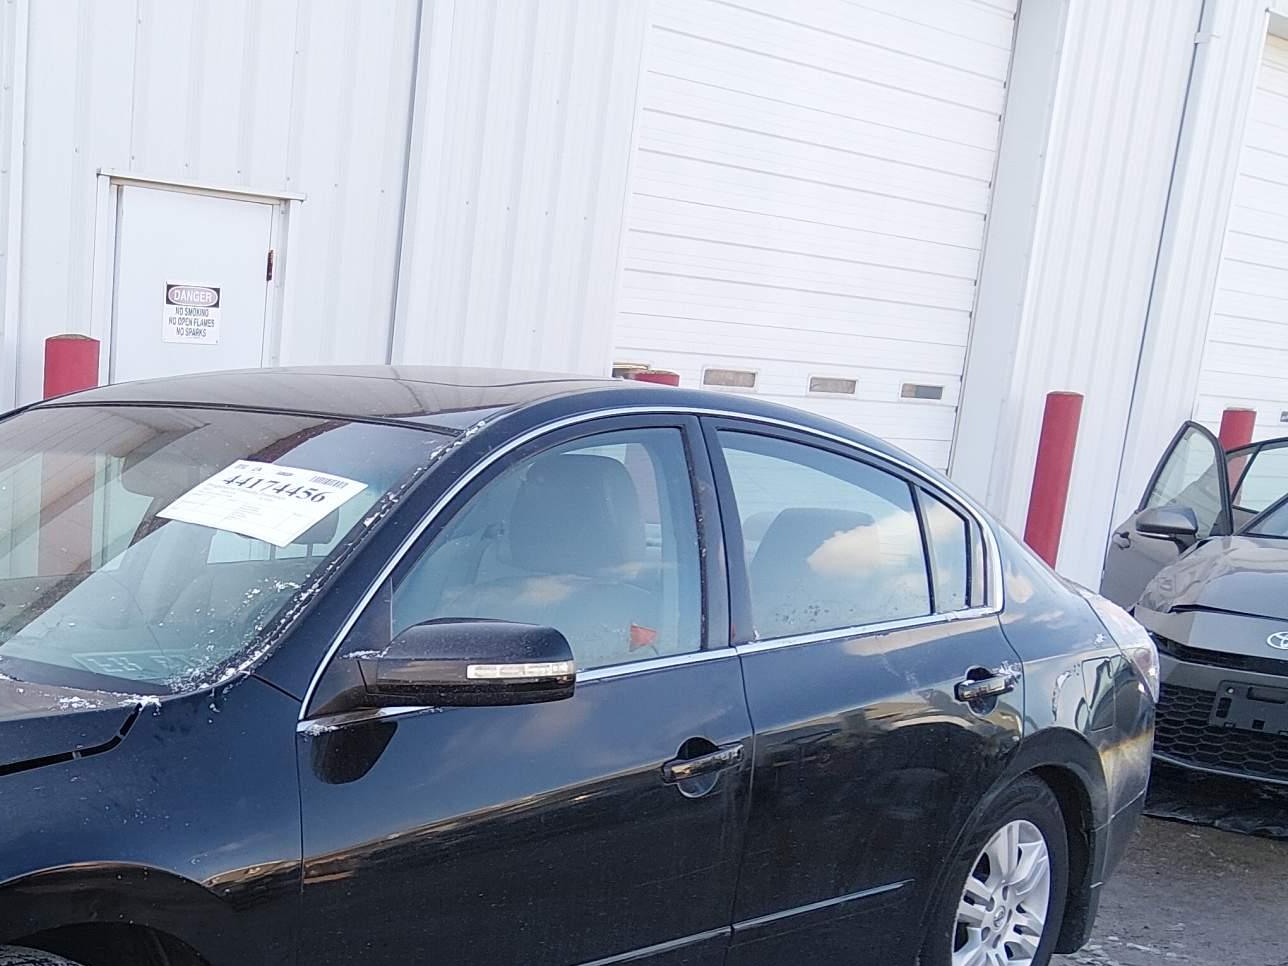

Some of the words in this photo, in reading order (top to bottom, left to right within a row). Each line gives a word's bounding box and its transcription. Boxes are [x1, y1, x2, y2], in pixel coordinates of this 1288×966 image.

[174, 289, 212, 303] DANGER
[176, 307, 183, 316] NO
[185, 307, 209, 317] SMOKING
[168, 317, 177, 326] NO
[177, 317, 193, 327] OPEN
[193, 318, 215, 328] FLAMES
[176, 326, 185, 336] NO
[185, 327, 207, 337] SPARKS
[224, 474, 331, 503] 44174456
